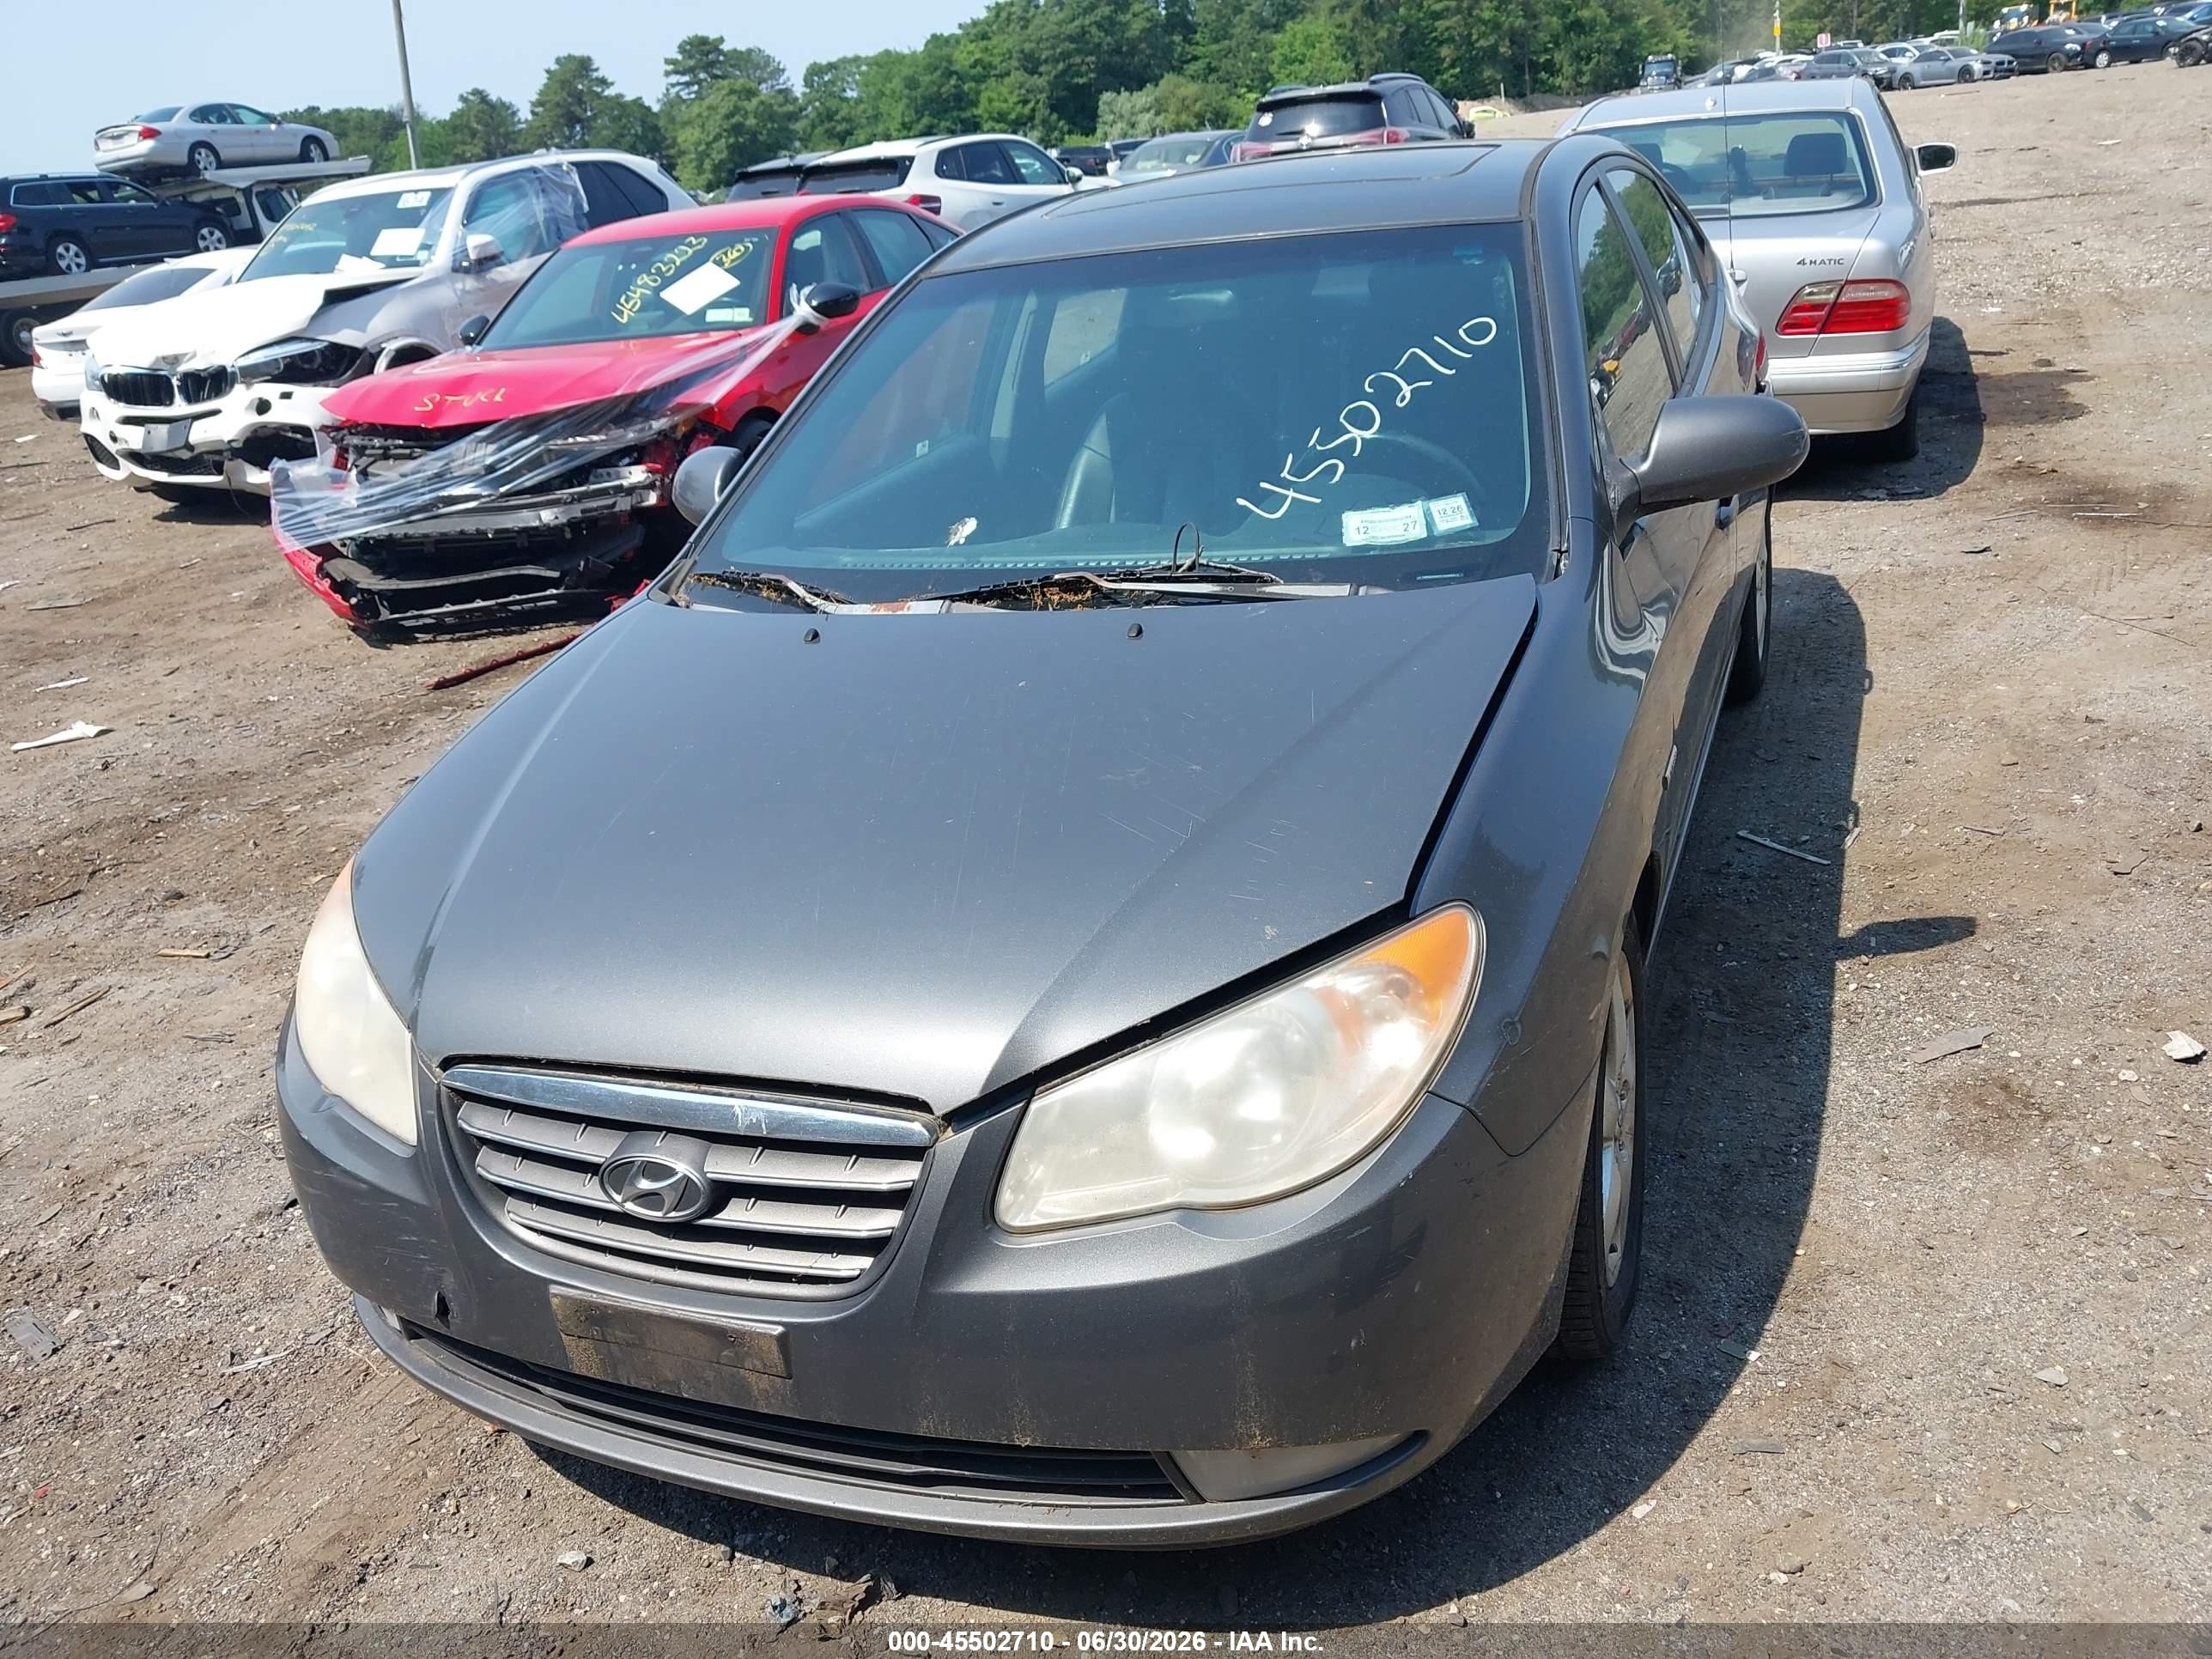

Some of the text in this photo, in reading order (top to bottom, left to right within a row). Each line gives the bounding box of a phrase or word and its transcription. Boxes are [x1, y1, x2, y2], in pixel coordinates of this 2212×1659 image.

[1236, 317, 1497, 520] 45502710
[1354, 520, 1418, 536] 12 27
